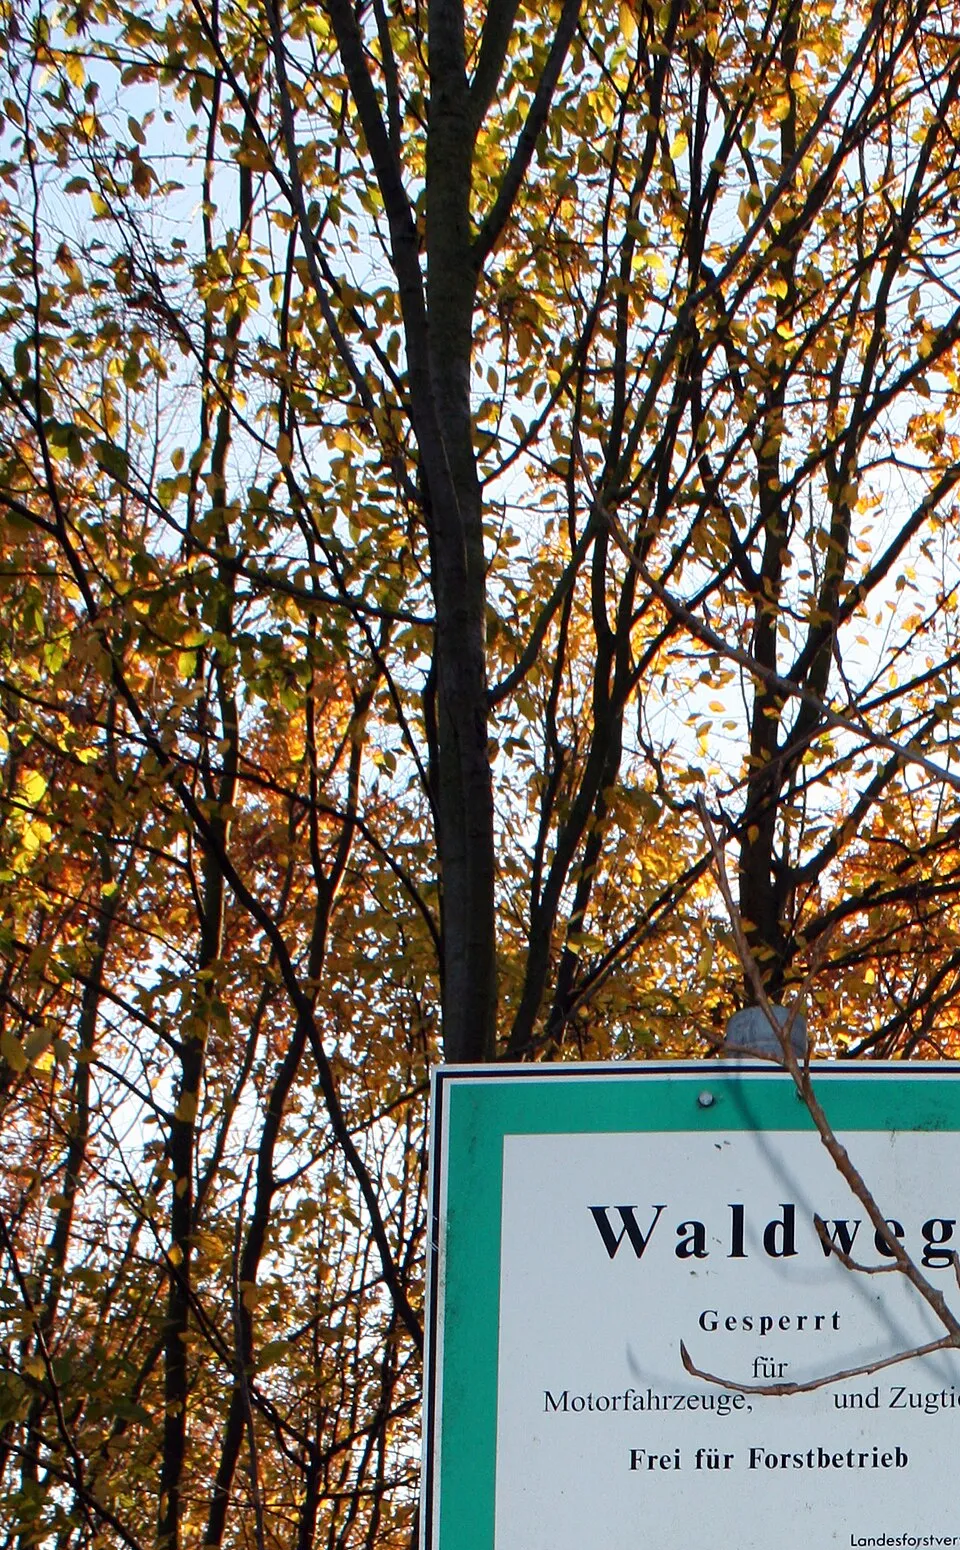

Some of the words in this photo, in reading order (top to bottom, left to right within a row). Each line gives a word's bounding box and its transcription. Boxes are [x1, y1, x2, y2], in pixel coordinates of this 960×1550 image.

[587, 1203, 957, 1268] Waldweg
[699, 1310, 841, 1335] Gesperrt
[752, 1355, 788, 1378] für
[544, 1389, 753, 1416] Motorfahrzeuge,
[833, 1387, 880, 1410] und
[629, 1449, 681, 1470] Frei
[695, 1448, 734, 1470] für
[749, 1447, 909, 1470] Forstbetrieb
